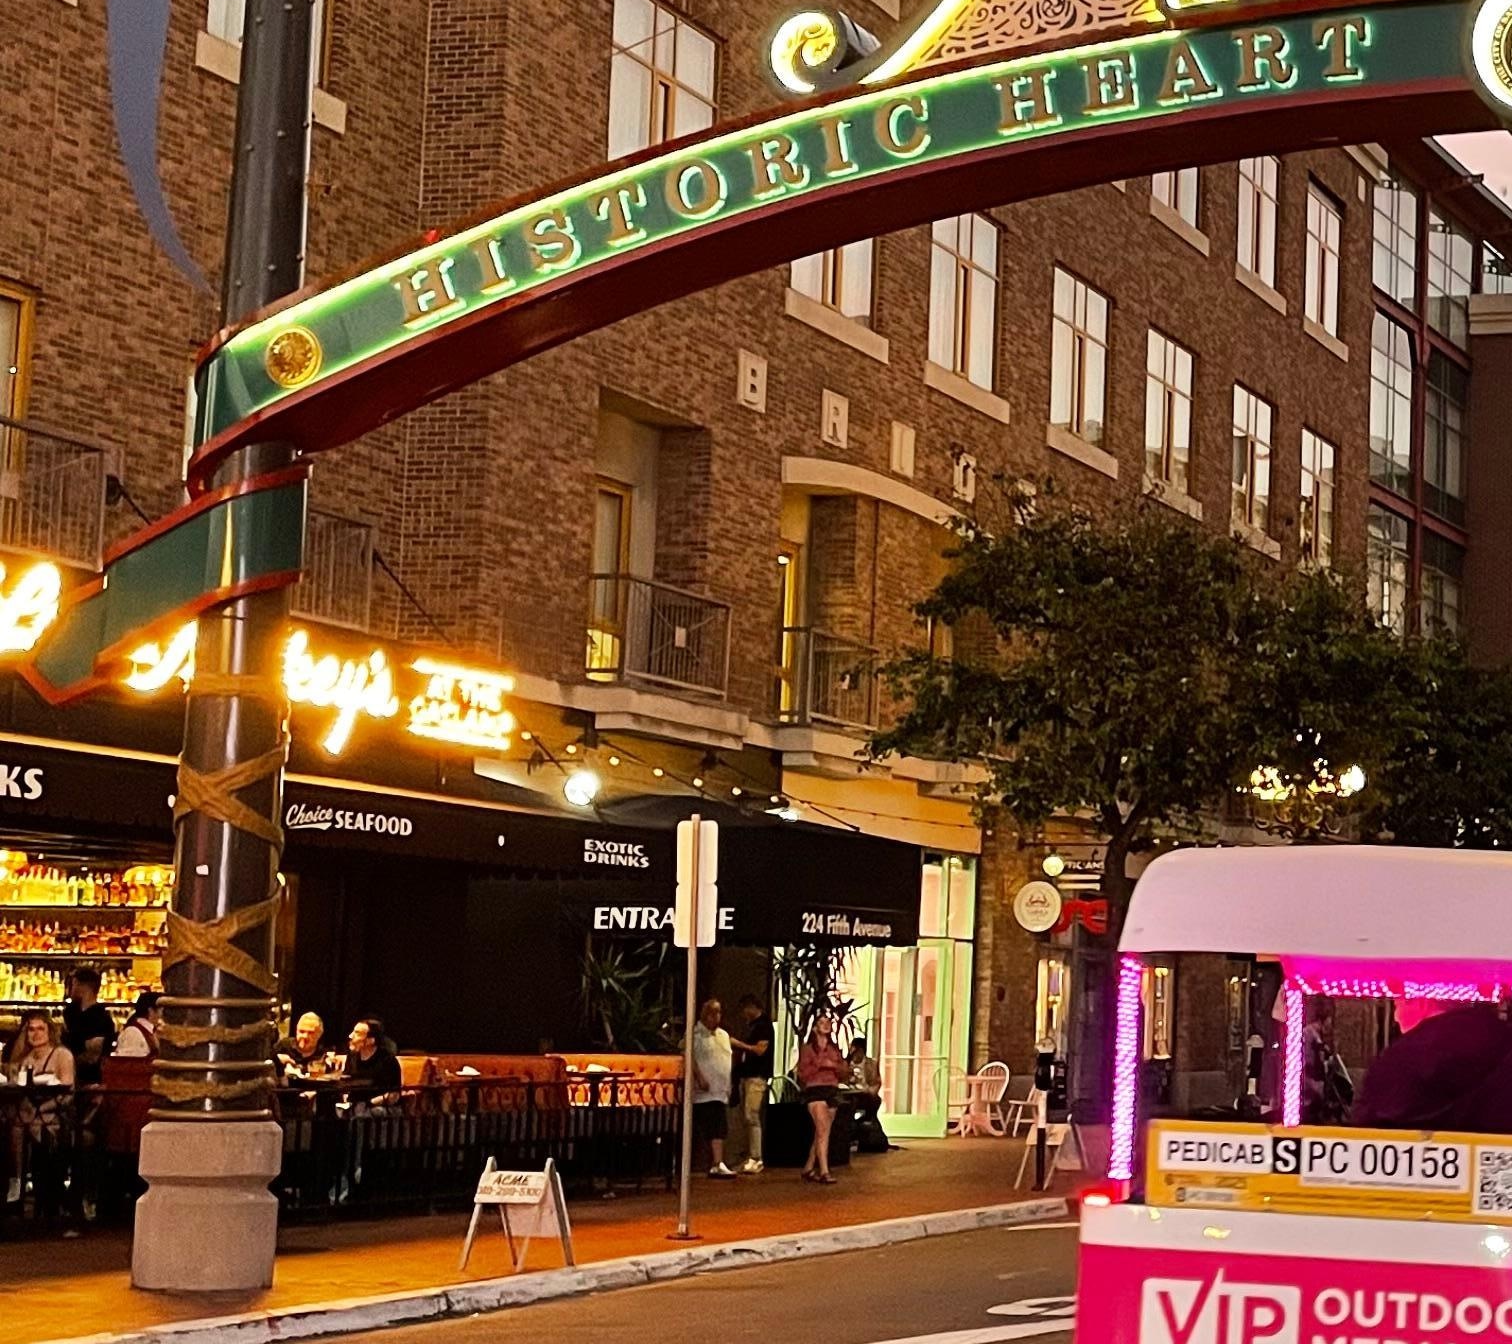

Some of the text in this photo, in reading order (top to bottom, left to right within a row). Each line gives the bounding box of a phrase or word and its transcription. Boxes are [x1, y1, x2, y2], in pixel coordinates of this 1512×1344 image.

[393, 94, 933, 330] HISTORIC
[997, 15, 1375, 139] HEART
[285, 803, 413, 836] Choice SEAFOOD
[584, 839, 645, 856] EXOTIC
[584, 851, 650, 868] DRINKS
[593, 907, 735, 930] ENTRAE
[802, 912, 891, 938] 224 Fifth Avenue
[1167, 1139, 1459, 1179] PEDICAB S PC 00158
